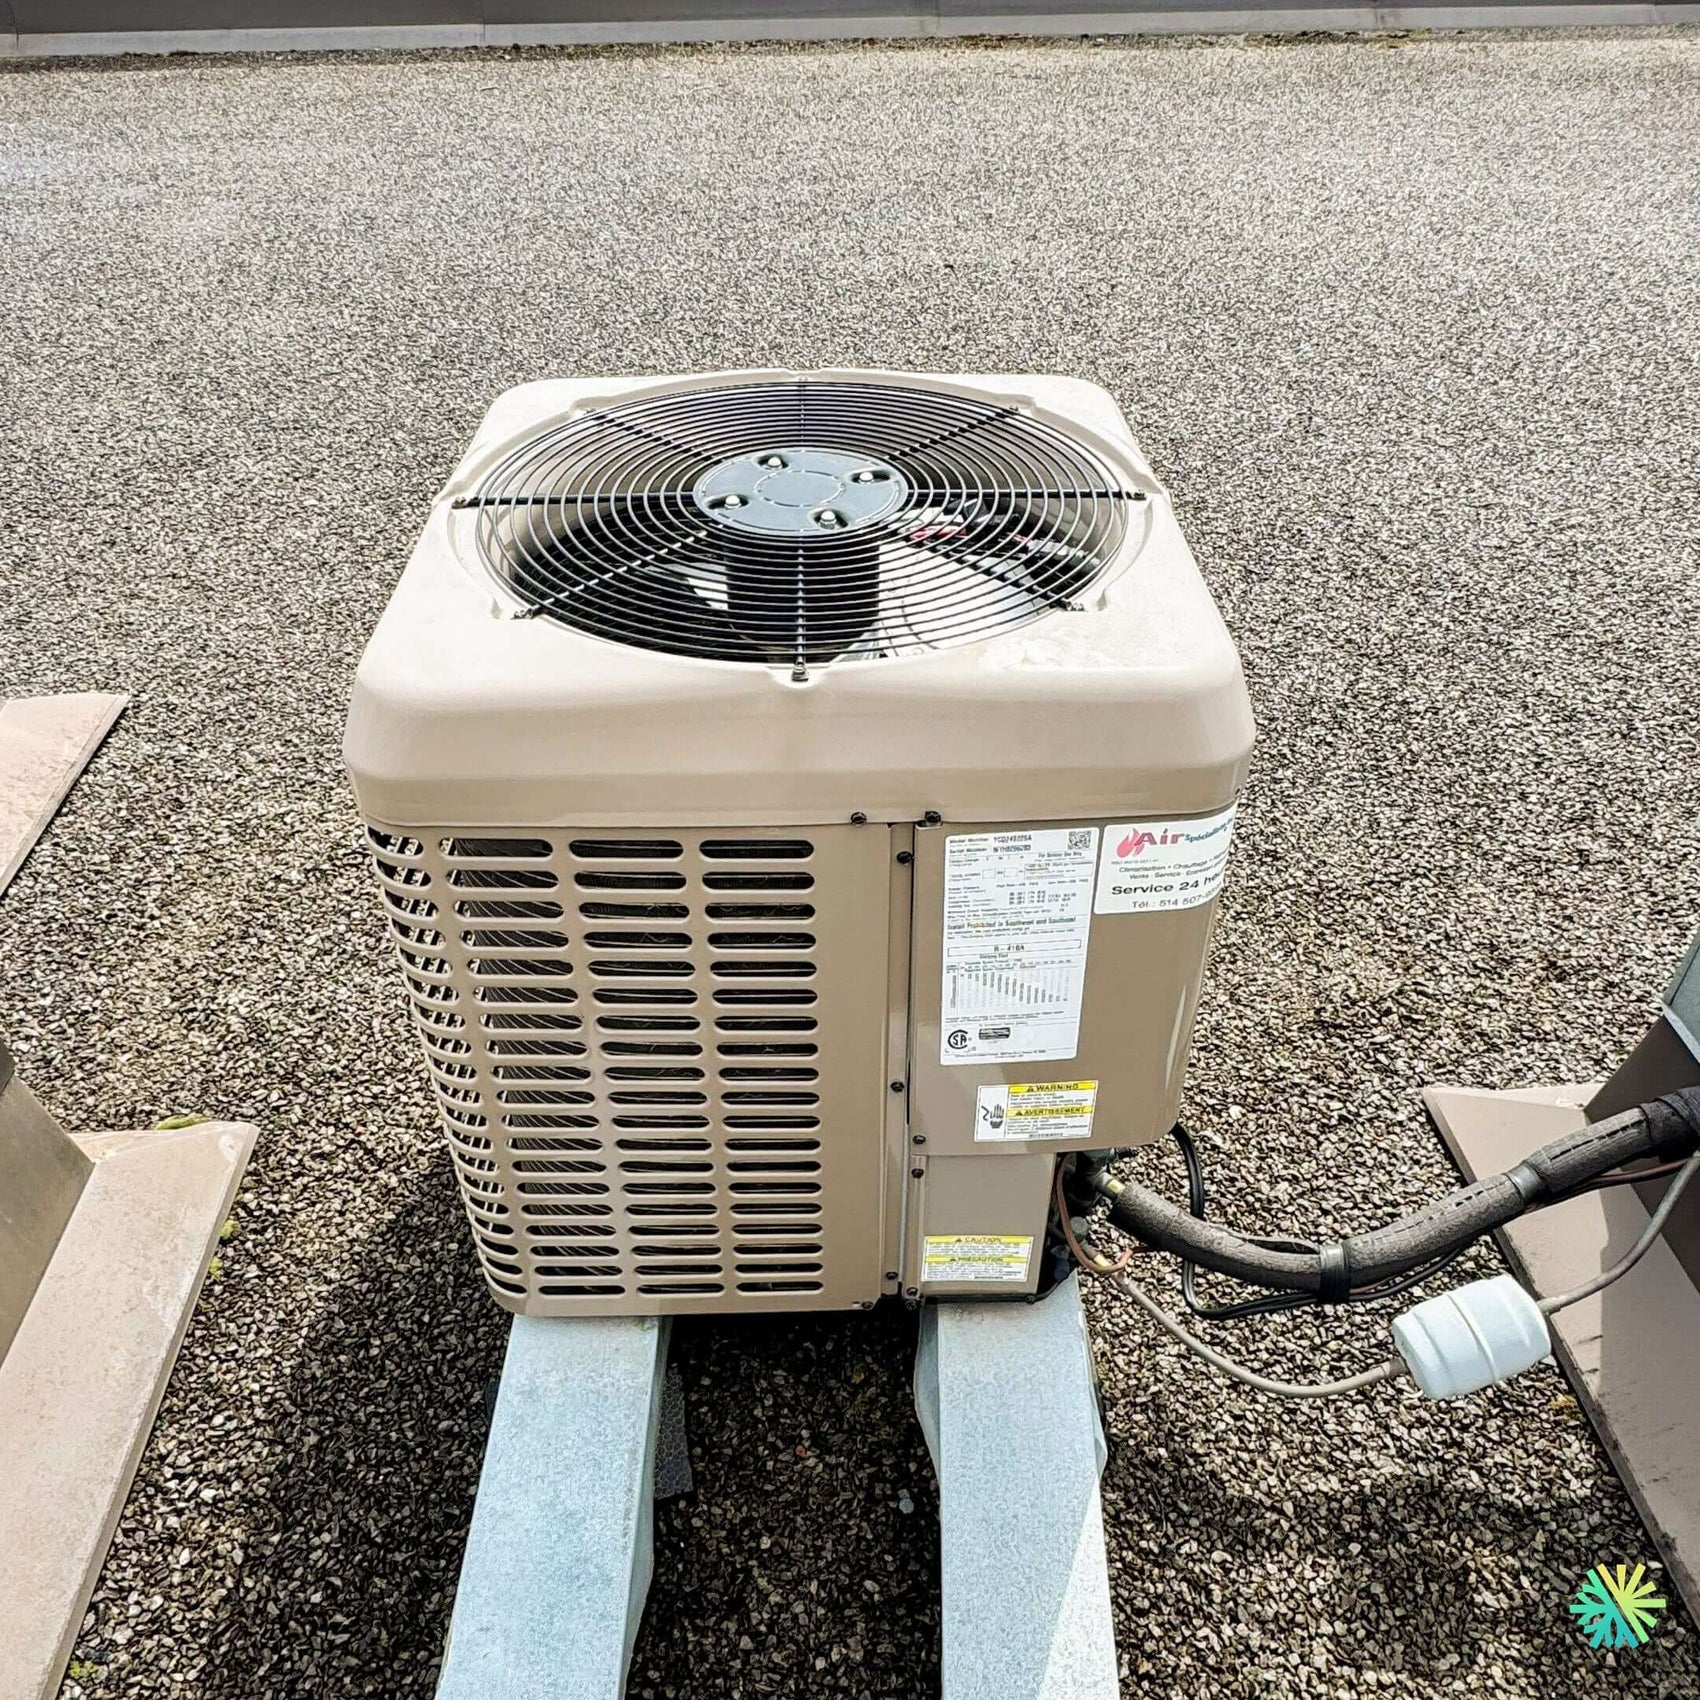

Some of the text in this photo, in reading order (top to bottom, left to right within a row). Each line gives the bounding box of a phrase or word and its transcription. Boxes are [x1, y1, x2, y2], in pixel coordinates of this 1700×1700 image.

[1134, 828, 1184, 846] Air
[1111, 883, 1174, 895] Service
[1179, 879, 1199, 891] 24
[1159, 899, 1178, 907] 514
[1036, 1083, 1079, 1092] WARNING
[1024, 1106, 1084, 1116] AVERTISSEMENT
